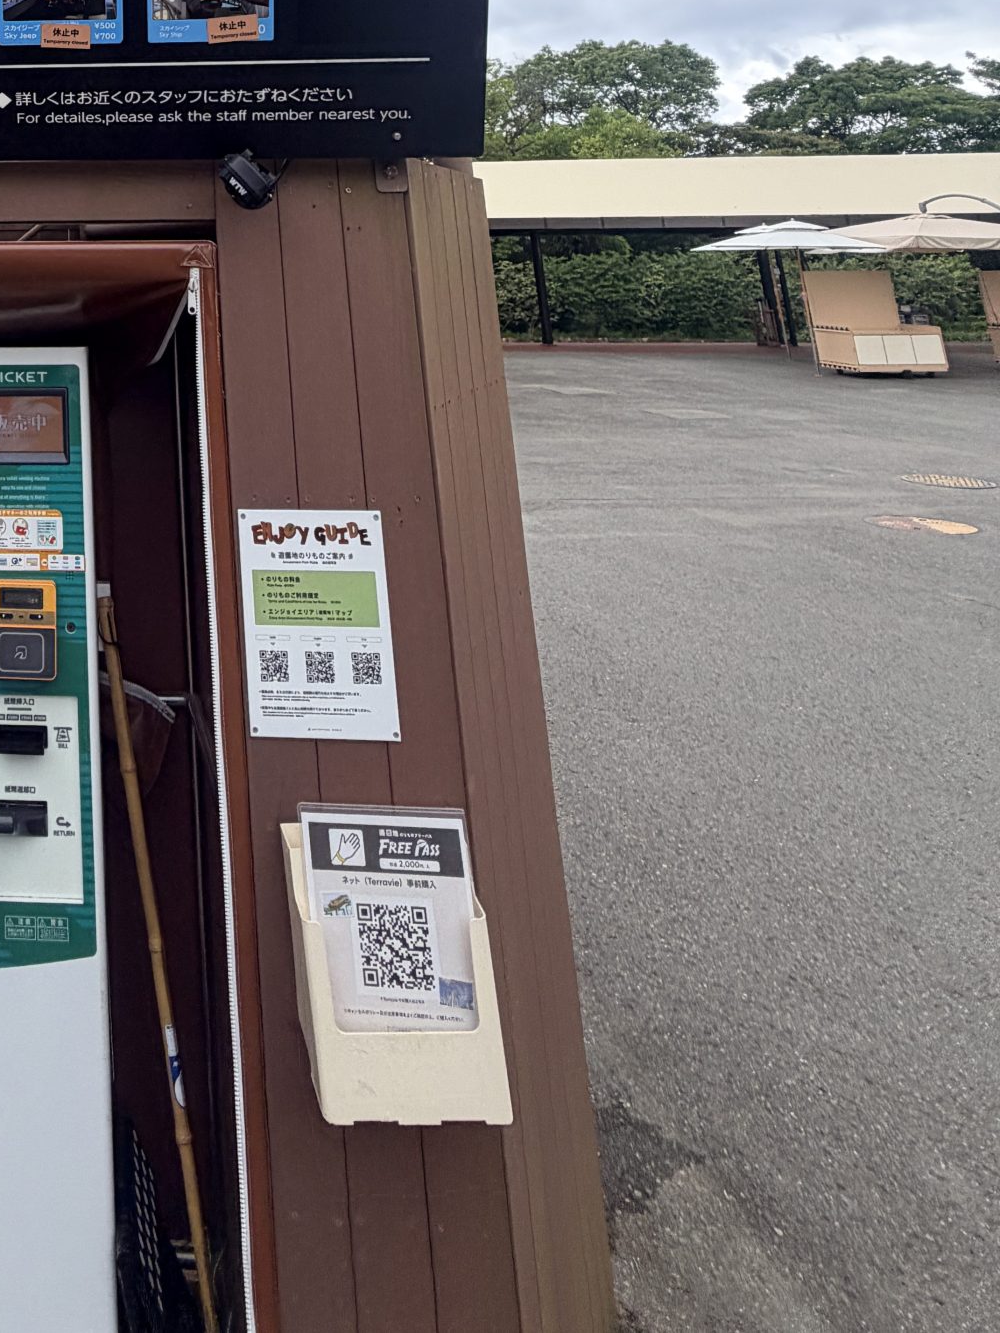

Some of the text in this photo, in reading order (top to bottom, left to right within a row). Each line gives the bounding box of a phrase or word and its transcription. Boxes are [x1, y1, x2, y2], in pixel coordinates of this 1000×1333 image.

[94, 21, 116, 30] ¥500
[219, 20, 247, 31] 休止中
[4, 32, 37, 40] Sky Jeep
[52, 27, 80, 38] 休止中
[94, 32, 116, 40] ¥700
[15, 88, 353, 107] 詳しくはお近くのスタッフにおたずねください
[17, 112, 40, 124] For
[158, 110, 183, 122] ask
[187, 110, 212, 122] the
[216, 109, 247, 121] staff
[252, 109, 314, 121] member
[319, 109, 375, 120] nearest
[379, 109, 412, 122] you.
[251, 521, 372, 546] ENJOY GUIDE
[378, 838, 441, 857] FREE PASS
